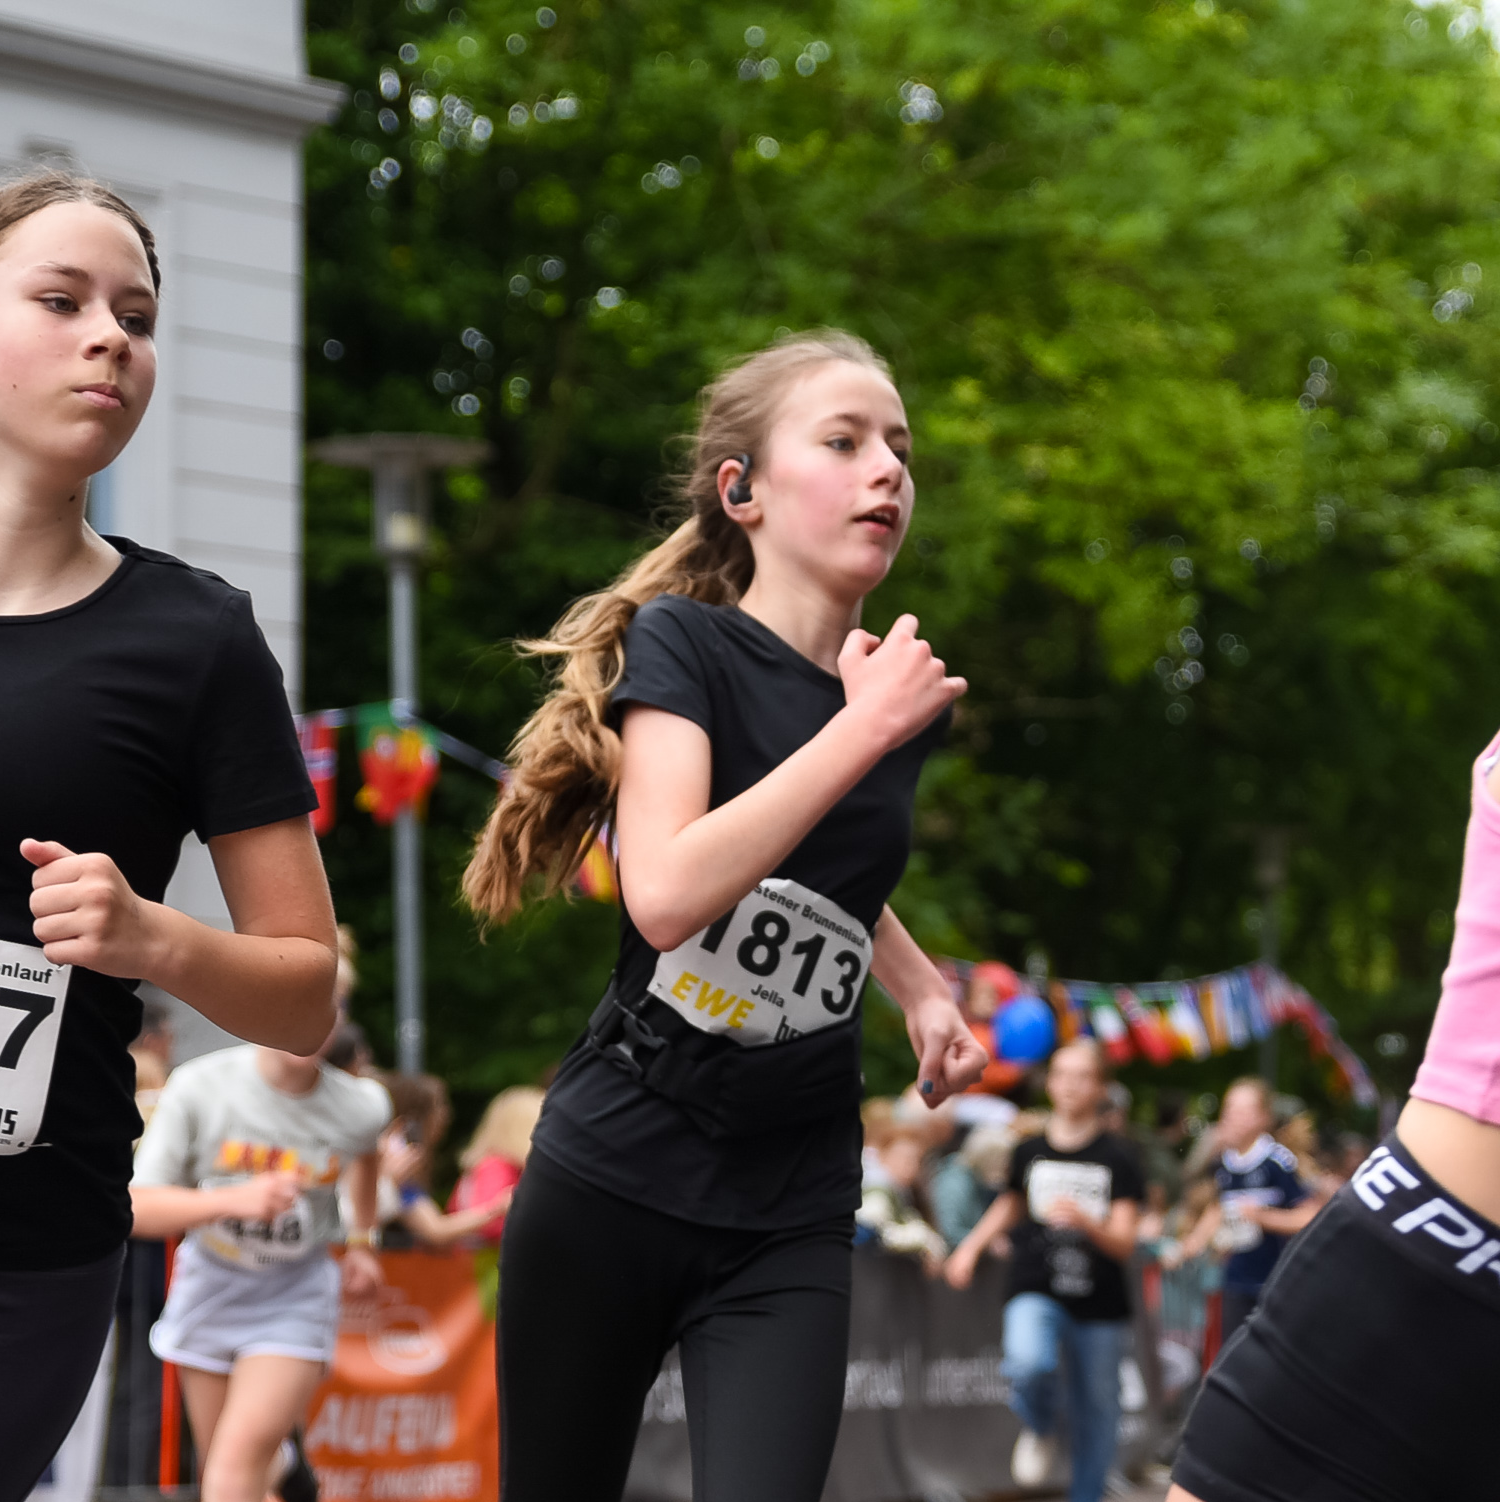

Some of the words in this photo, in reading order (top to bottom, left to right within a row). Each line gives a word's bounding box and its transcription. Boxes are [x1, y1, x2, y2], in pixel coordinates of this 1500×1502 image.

[753, 885, 800, 912] stener
[670, 970, 756, 1029] EWE
[750, 983, 786, 1009] Jella
